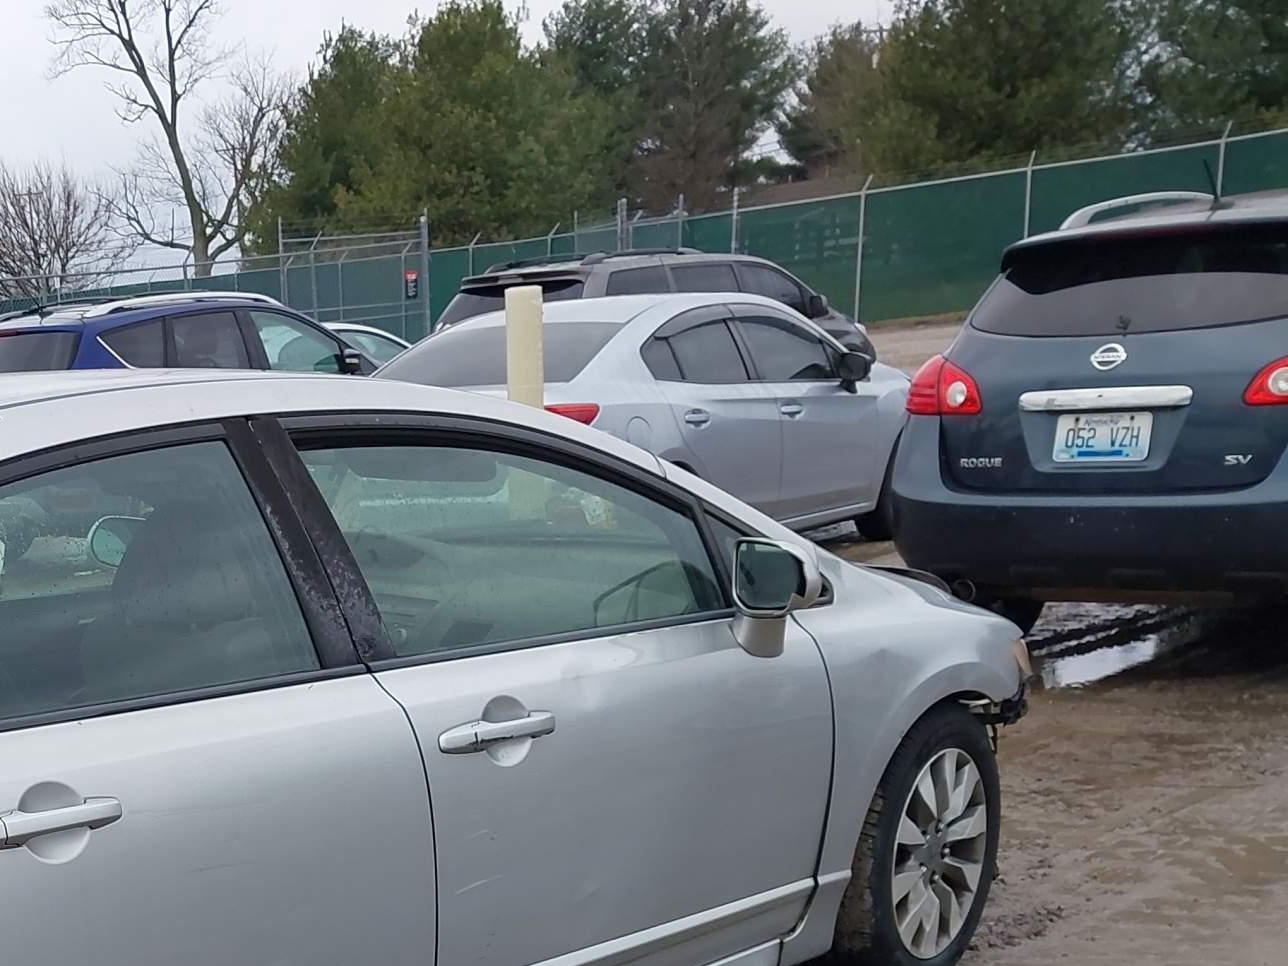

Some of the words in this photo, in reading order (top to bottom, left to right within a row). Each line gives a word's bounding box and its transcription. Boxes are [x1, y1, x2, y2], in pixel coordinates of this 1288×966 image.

[1065, 427, 1097, 448] 052
[1110, 426, 1141, 448] VZH
[960, 457, 1002, 468] ROGUE
[1224, 454, 1253, 465] SV
